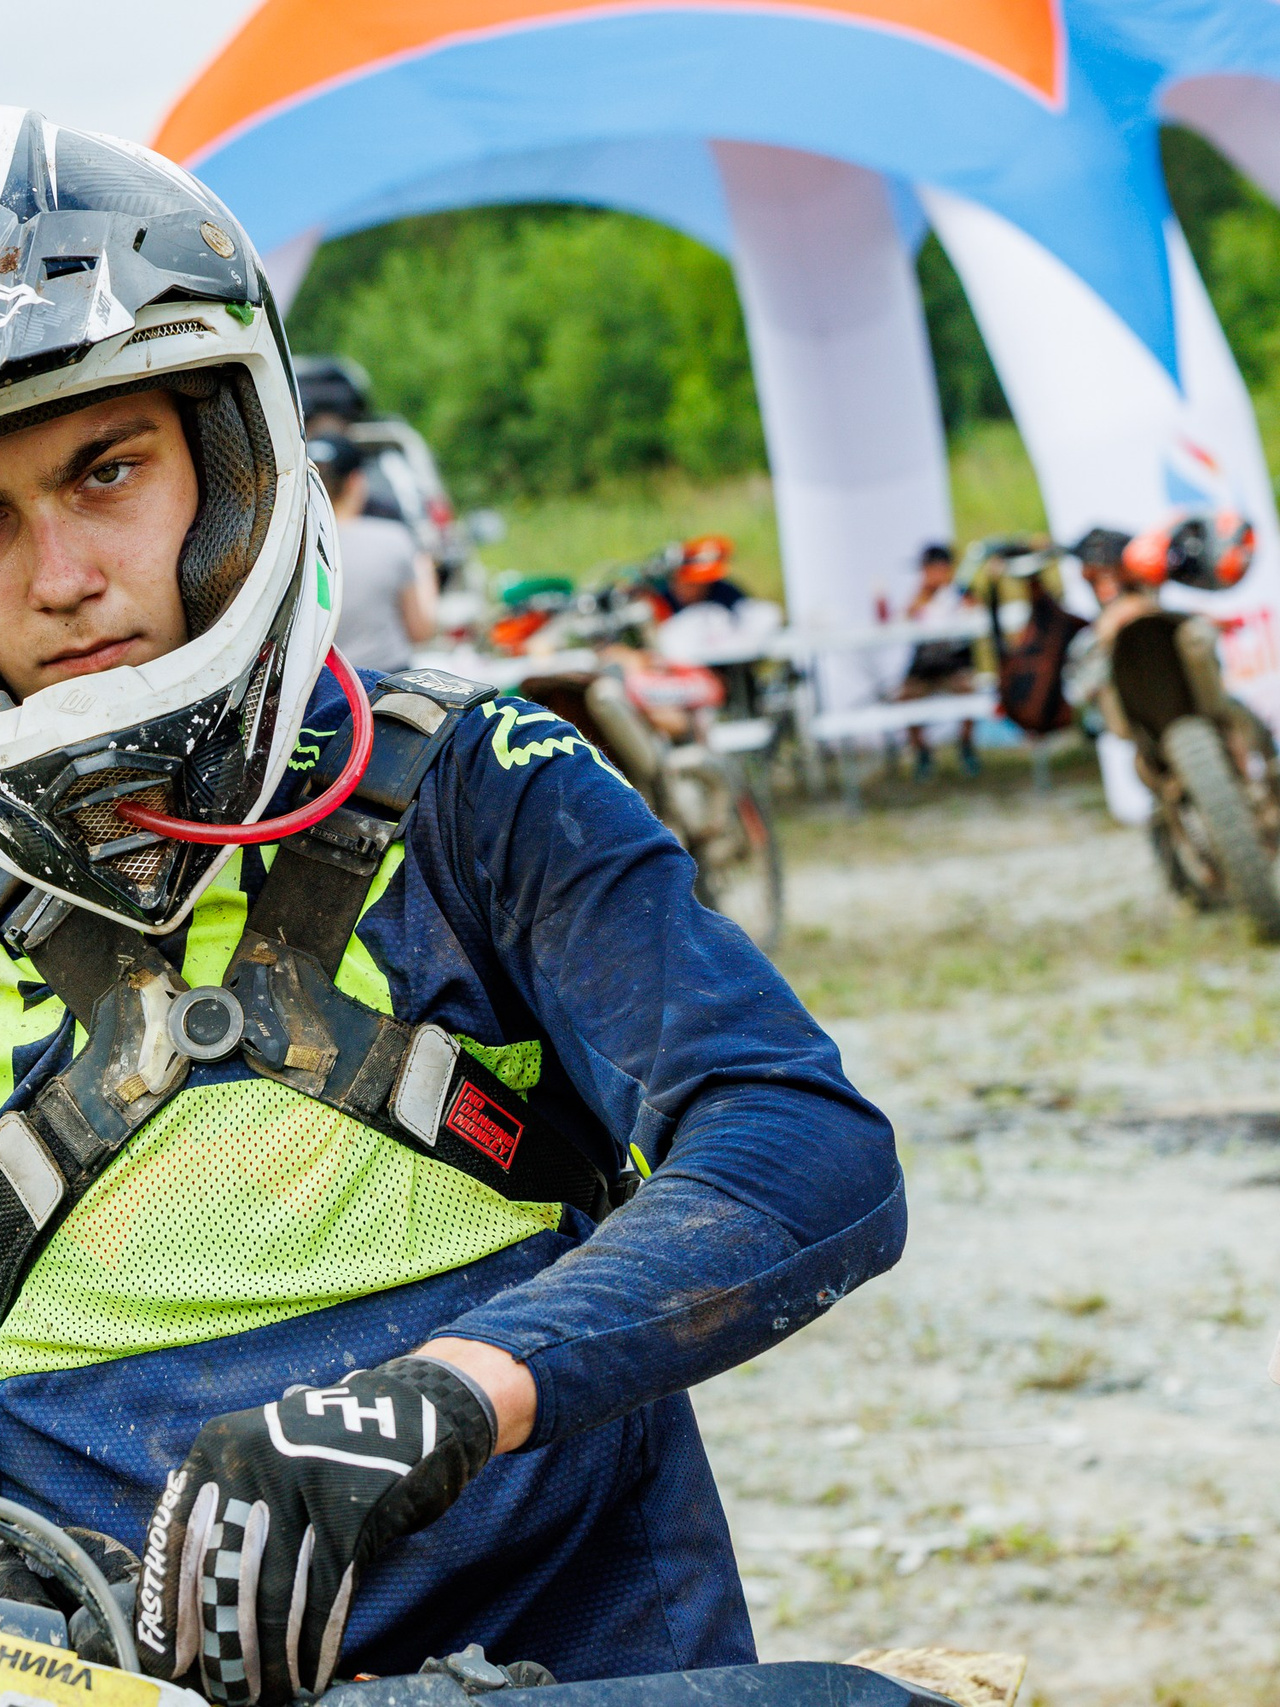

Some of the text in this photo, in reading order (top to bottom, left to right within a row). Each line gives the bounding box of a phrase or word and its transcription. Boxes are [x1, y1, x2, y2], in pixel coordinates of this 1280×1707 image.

[464, 1090, 485, 1110] NO
[454, 1114, 510, 1157] MONKEY
[458, 1101, 515, 1148] DANCING
[137, 1469, 188, 1655] FASTHOUSE
